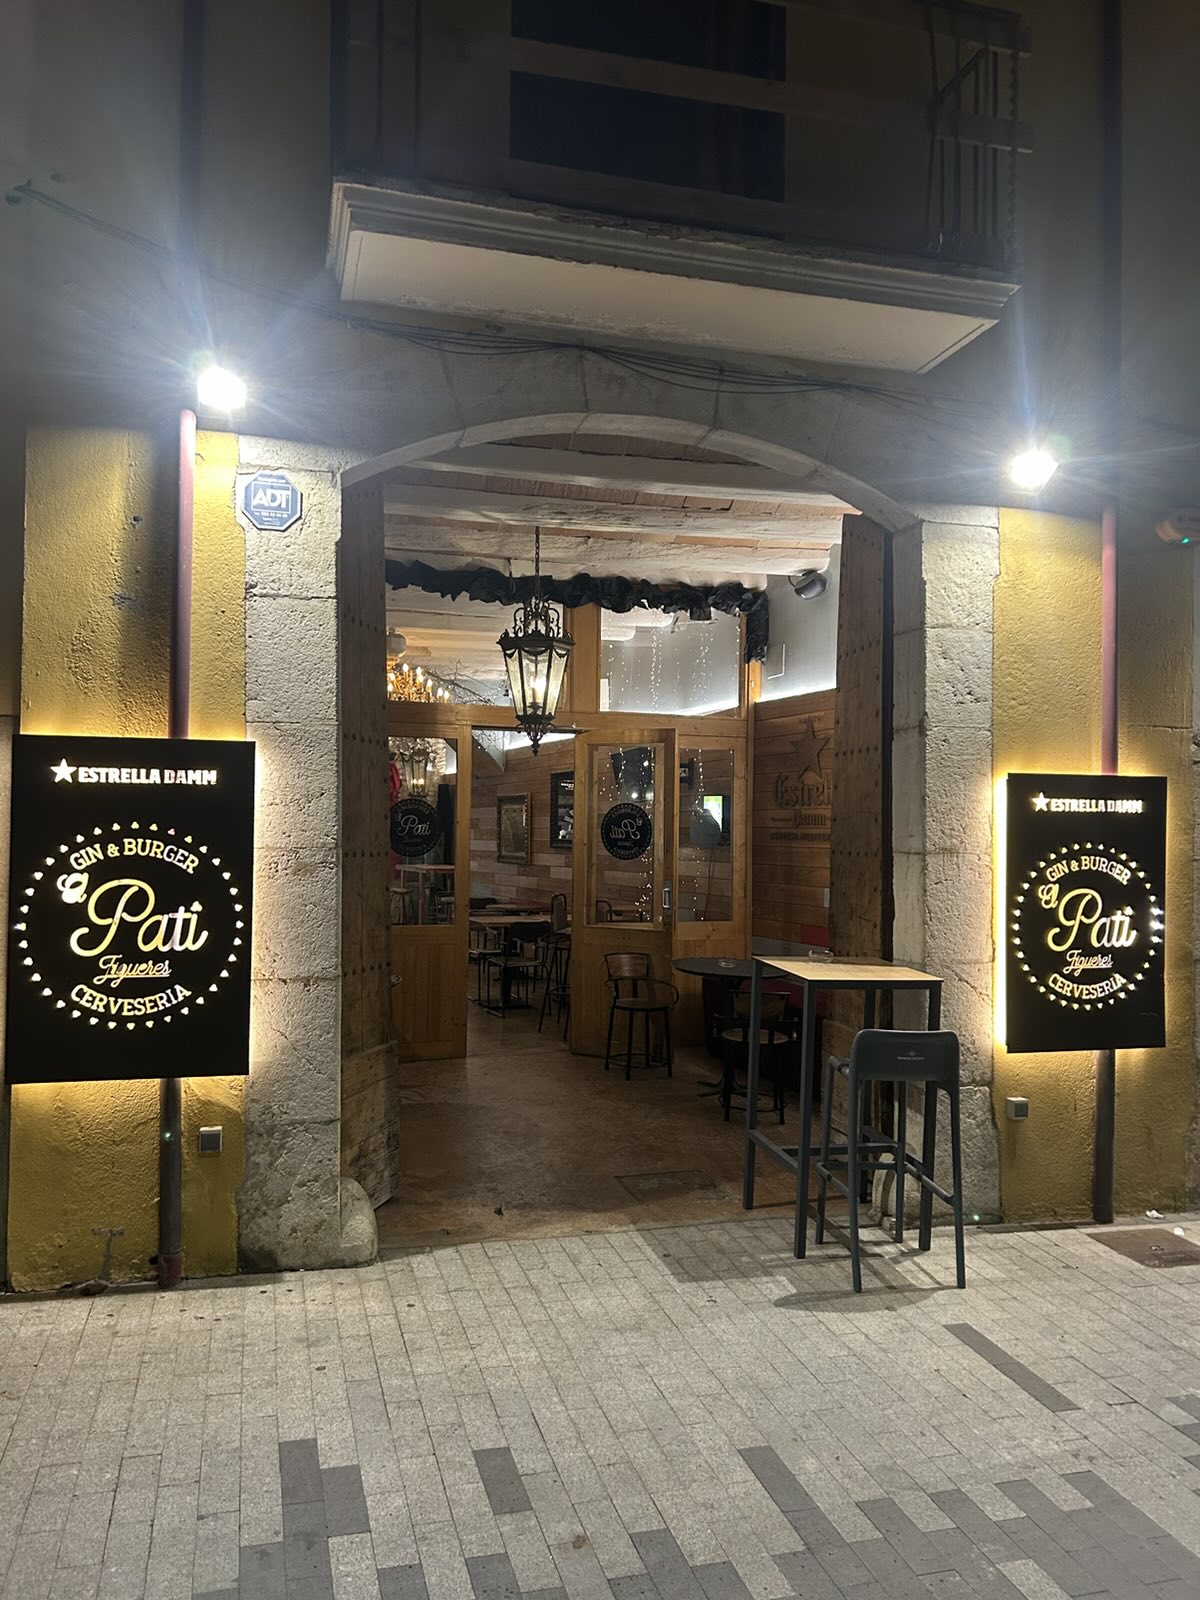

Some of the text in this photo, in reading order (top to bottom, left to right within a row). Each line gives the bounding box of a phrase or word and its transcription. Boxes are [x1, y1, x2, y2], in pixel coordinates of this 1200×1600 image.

[253, 488, 290, 508] ADT
[78, 767, 217, 785] ESTRELLA DAMM
[1050, 798, 1143, 813] ESTRELLA DAMM
[397, 815, 432, 836] Pati
[69, 838, 199, 874] GIN & BURGER
[1046, 856, 1131, 885] GIN & BURGER
[70, 879, 209, 957] Pati
[1047, 888, 1137, 952] Pati
[93, 954, 172, 988] Figueres
[1063, 949, 1113, 977] Figueres
[70, 983, 192, 1016] CERVESERIA
[1048, 973, 1127, 999] CERVESERIA
